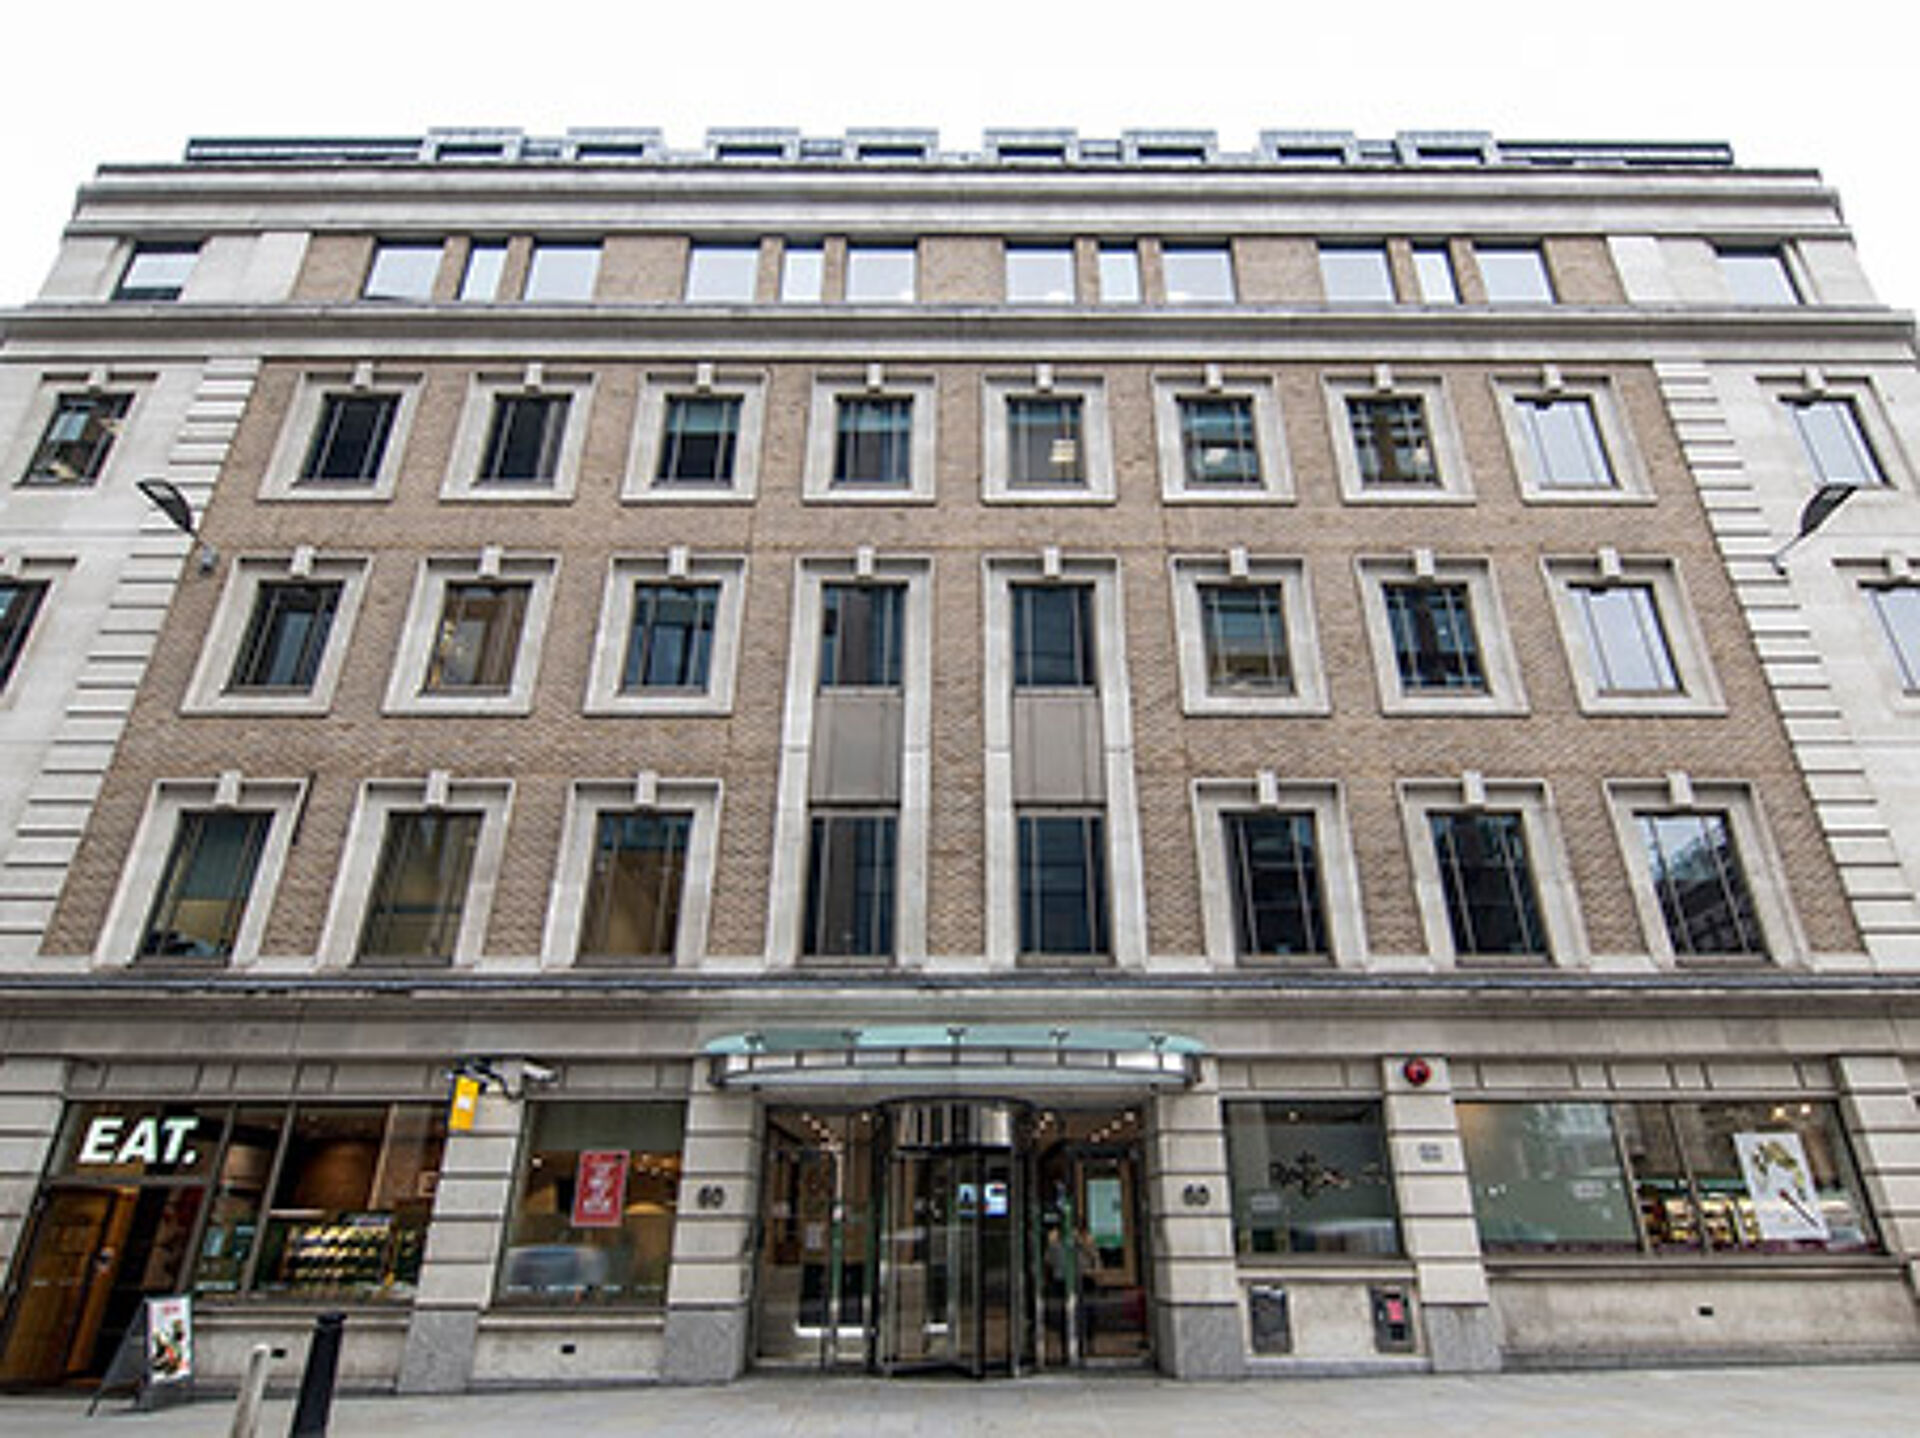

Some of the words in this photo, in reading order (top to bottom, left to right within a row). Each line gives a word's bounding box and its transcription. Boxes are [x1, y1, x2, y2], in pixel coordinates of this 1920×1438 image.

[78, 1116, 199, 1164] EAT.
[697, 1184, 726, 1209] 60
[1182, 1183, 1211, 1208] 60
